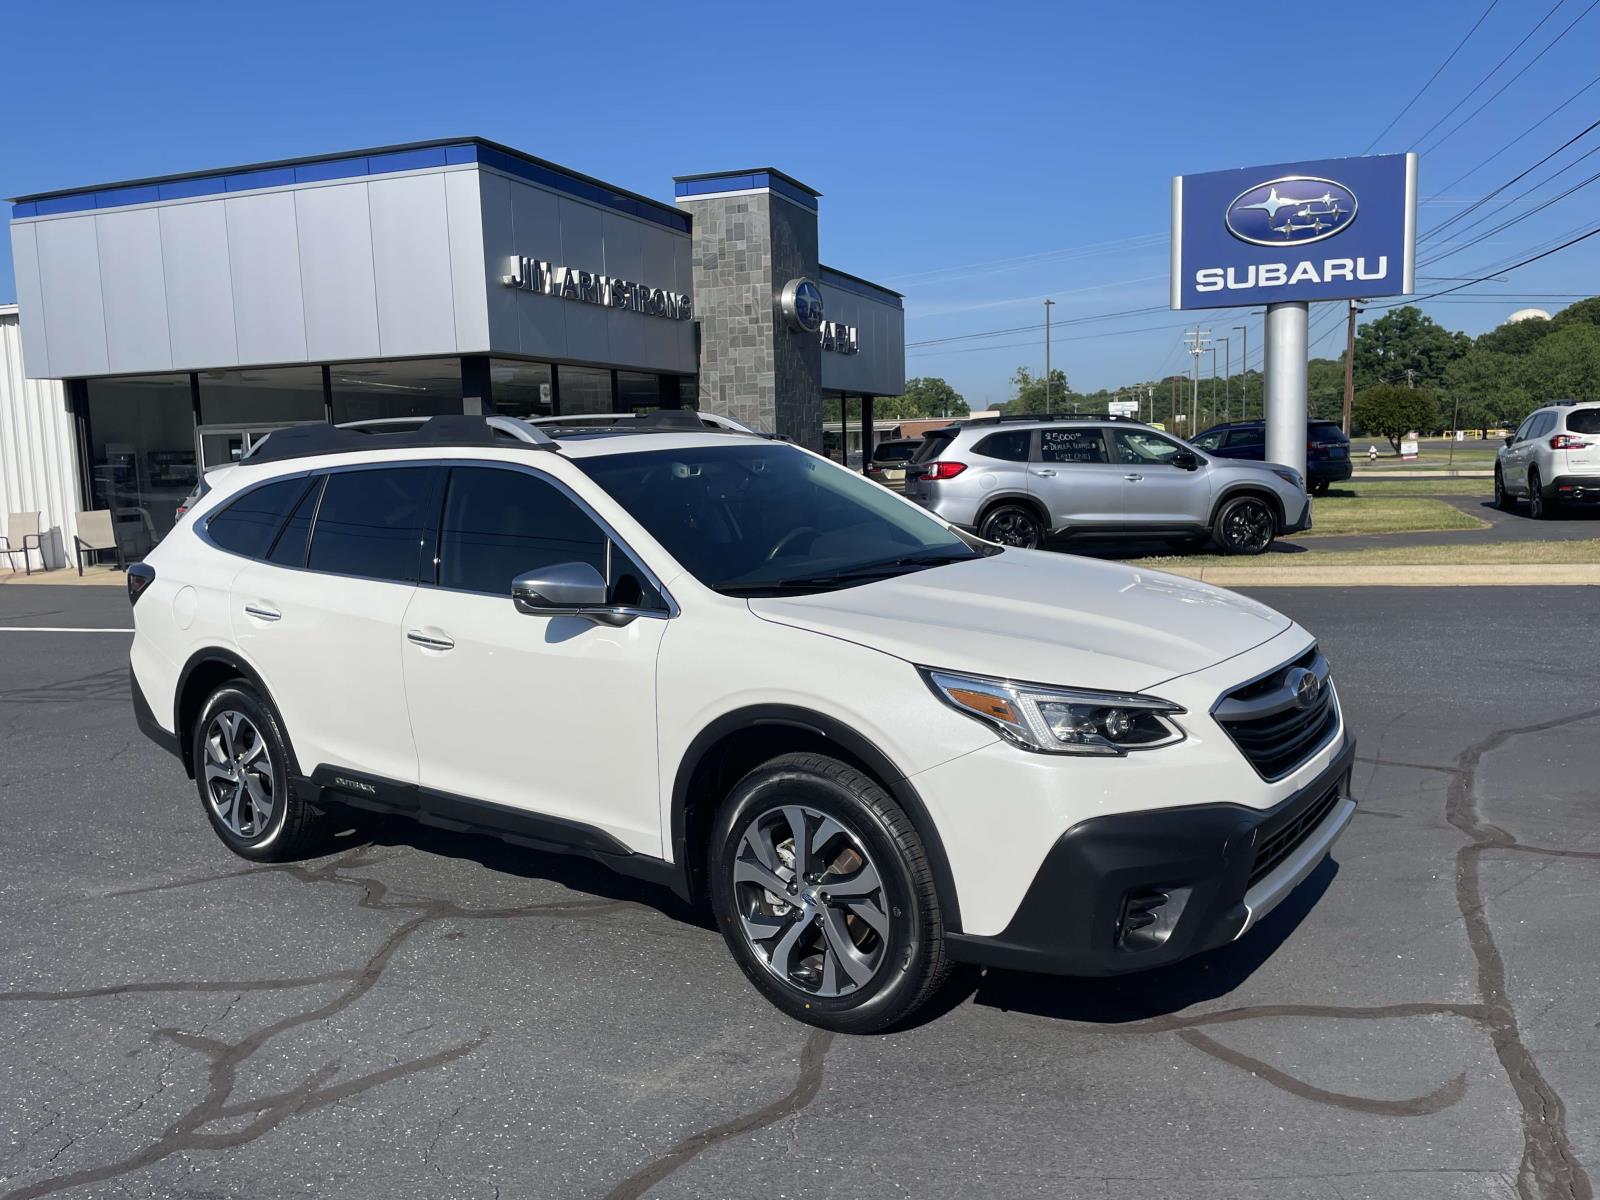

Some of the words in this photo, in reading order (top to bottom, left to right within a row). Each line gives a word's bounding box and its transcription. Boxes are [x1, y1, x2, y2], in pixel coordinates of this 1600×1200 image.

[503, 255, 555, 296] JIM
[557, 266, 693, 321] ARMSTRONG
[1195, 255, 1388, 293] SUBARU
[819, 320, 860, 354] ARU
[335, 777, 376, 794] OUTBACK
